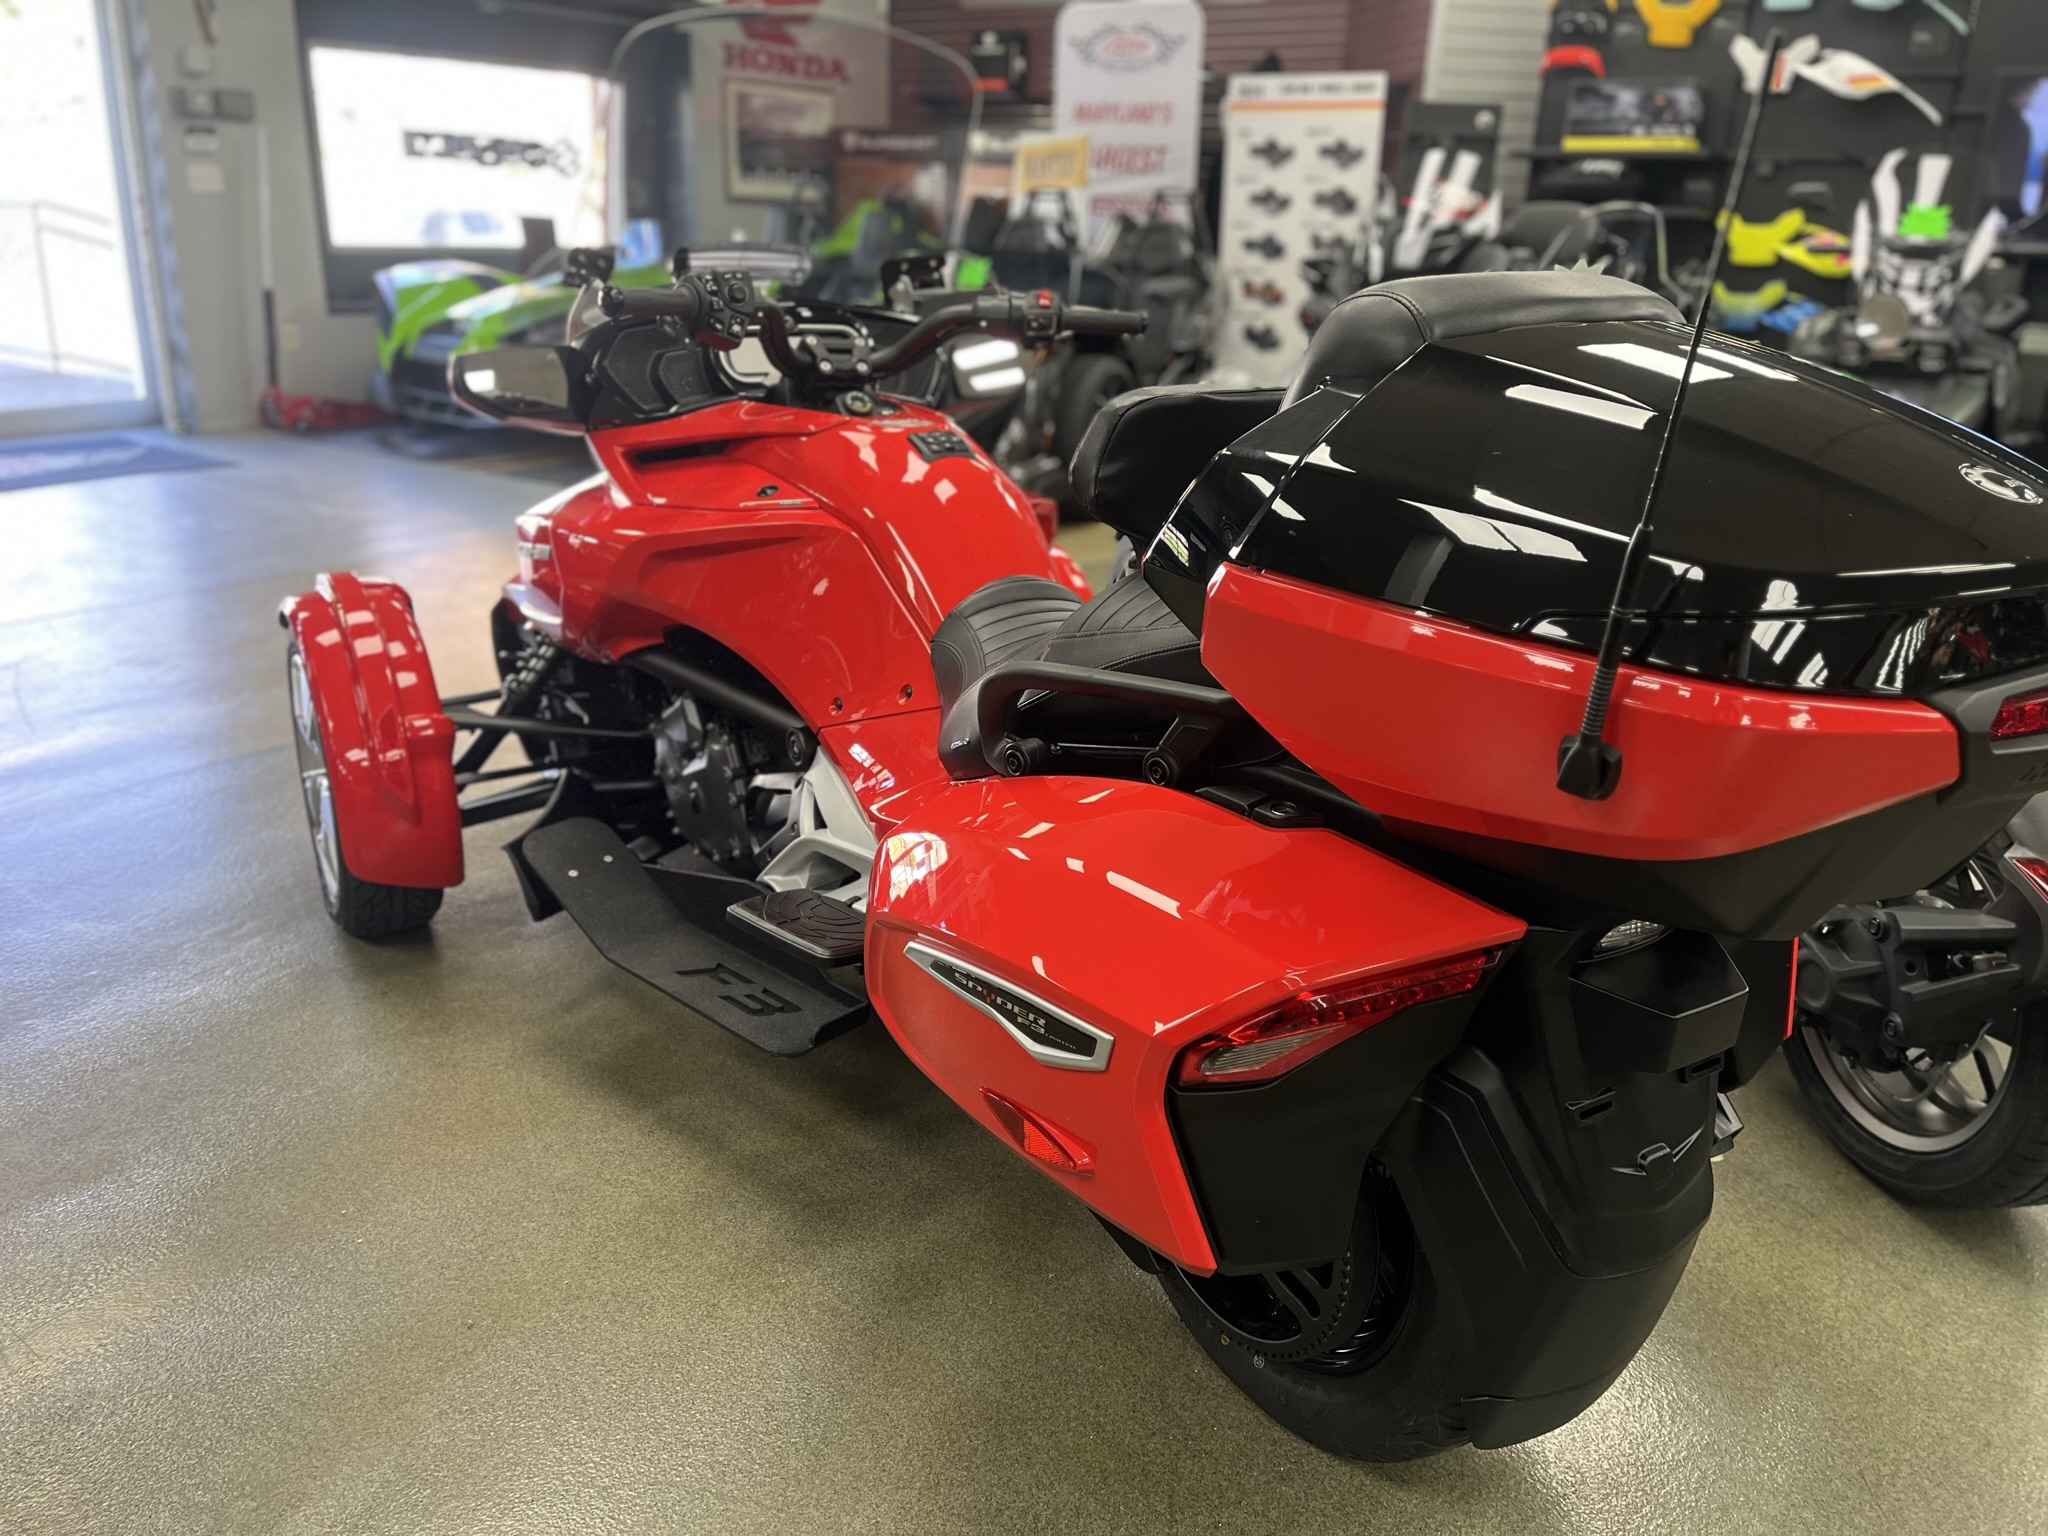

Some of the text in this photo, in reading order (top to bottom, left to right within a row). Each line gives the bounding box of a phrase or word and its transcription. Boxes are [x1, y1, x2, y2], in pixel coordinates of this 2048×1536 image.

[723, 43, 849, 83] HONDA
[674, 962, 802, 1016] F3
[953, 971, 1046, 1028] SPYDER
[1016, 1015, 1046, 1036] F3
